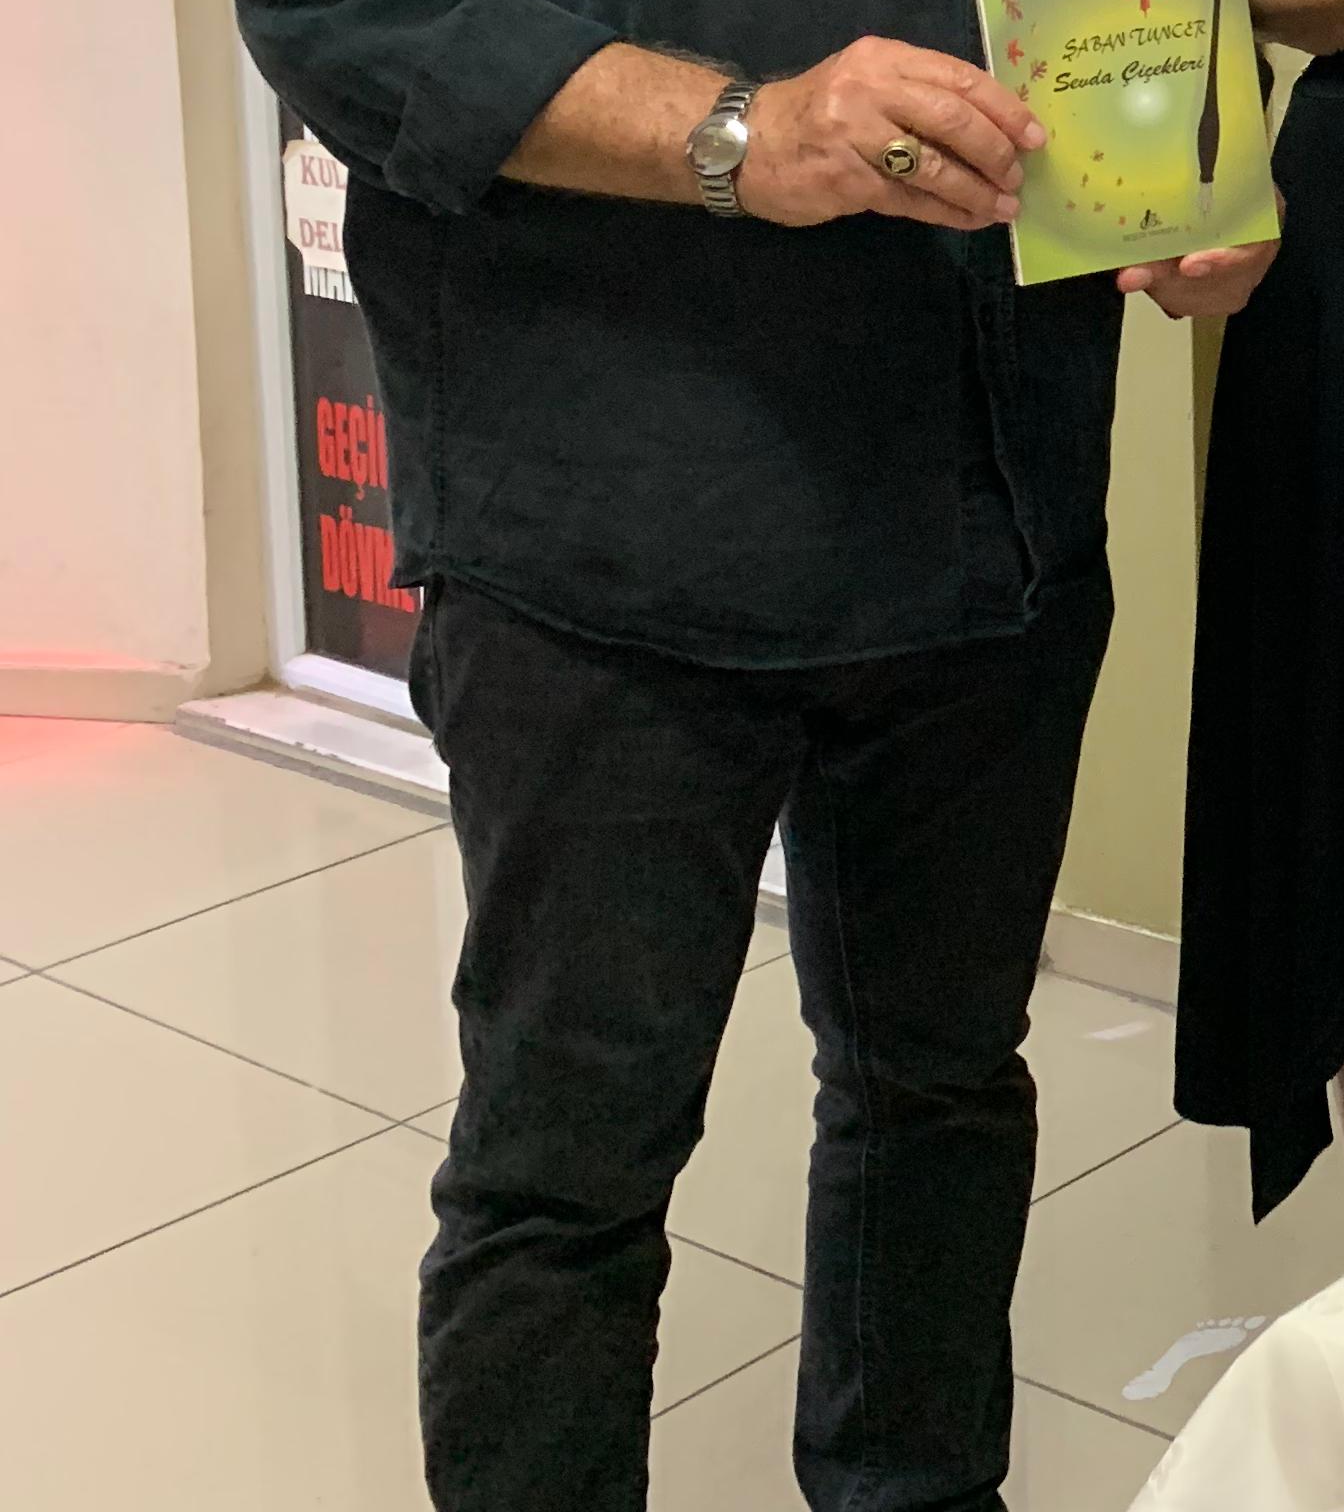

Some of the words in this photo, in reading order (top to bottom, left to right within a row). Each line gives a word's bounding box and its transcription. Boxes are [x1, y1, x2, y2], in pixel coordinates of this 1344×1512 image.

[1062, 31, 1129, 62] ŞABAN
[1129, 19, 1207, 52] TUNCER
[1053, 65, 1113, 94] Sevda
[1121, 54, 1206, 88] Çiçekleri
